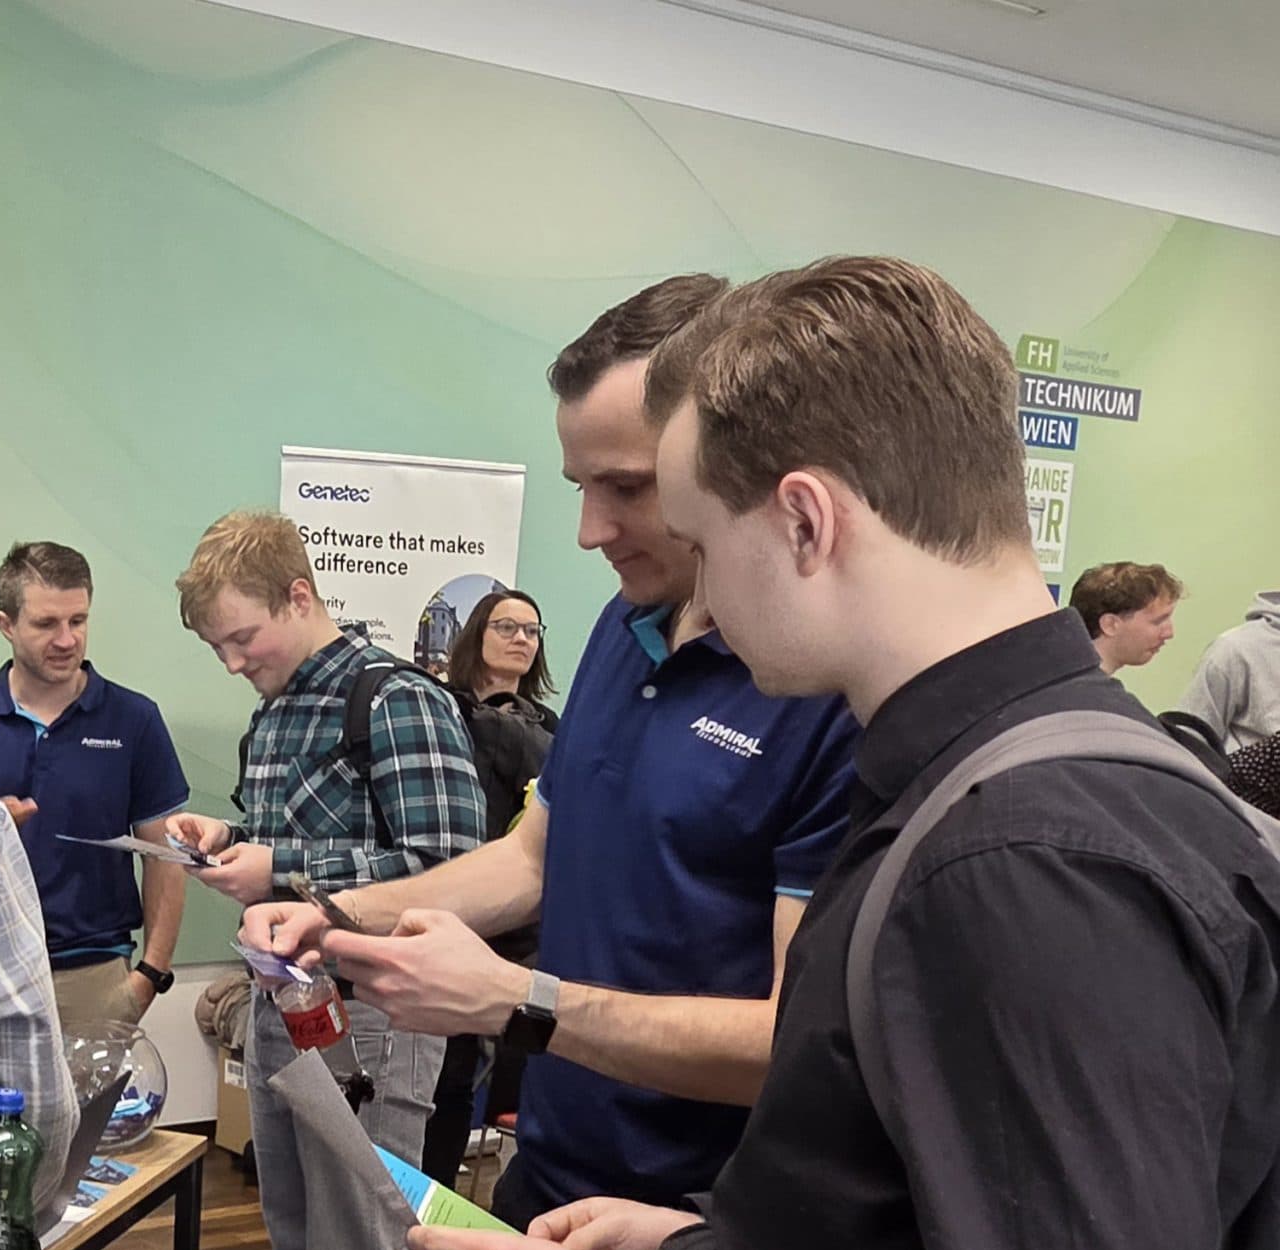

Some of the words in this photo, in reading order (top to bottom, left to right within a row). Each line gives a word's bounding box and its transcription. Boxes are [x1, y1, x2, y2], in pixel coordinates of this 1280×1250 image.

[1027, 341, 1052, 368] FH
[1025, 378, 1135, 417] TECHNIKUM
[1022, 416, 1073, 446] WIEN
[299, 482, 371, 503] Genetec
[298, 526, 383, 549] Software
[389, 531, 425, 552] that
[430, 536, 485, 555] makes
[314, 553, 409, 576] difference
[690, 716, 763, 755] ADMIRAL
